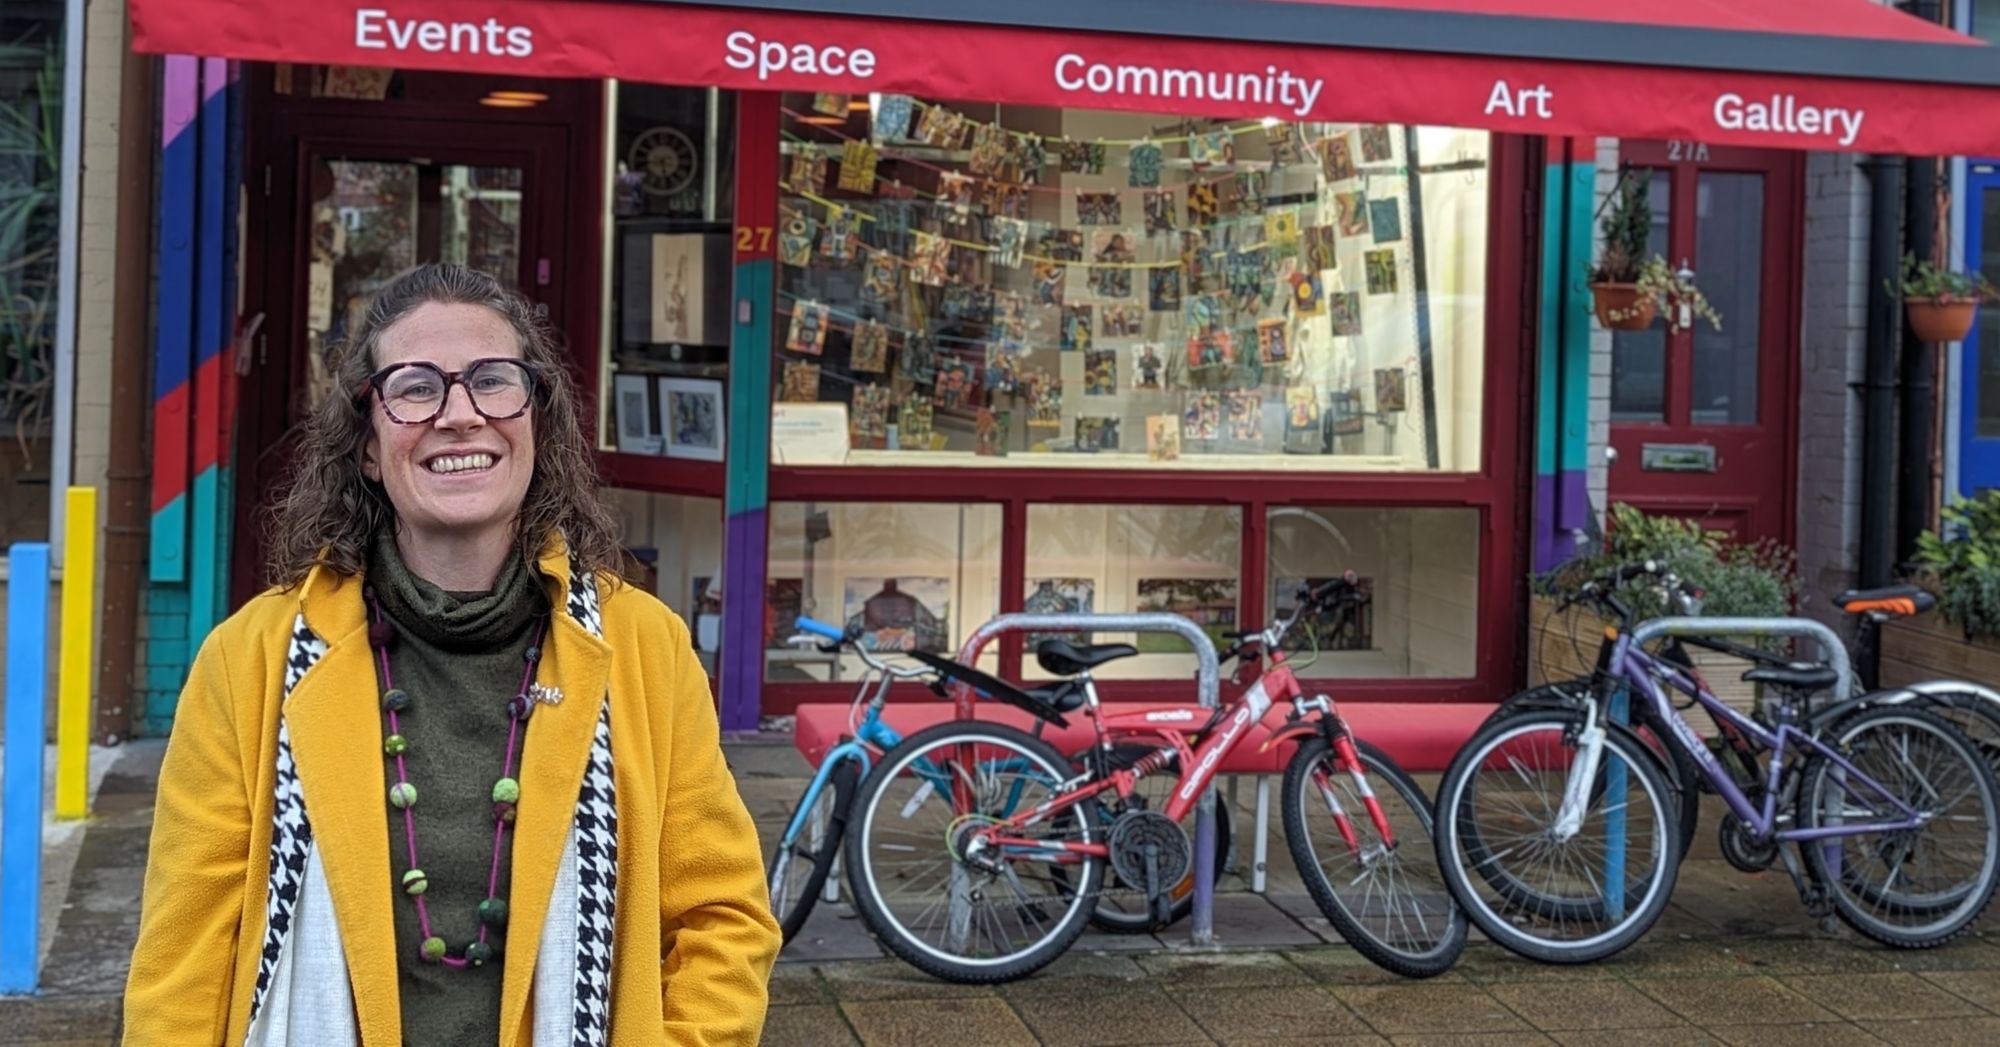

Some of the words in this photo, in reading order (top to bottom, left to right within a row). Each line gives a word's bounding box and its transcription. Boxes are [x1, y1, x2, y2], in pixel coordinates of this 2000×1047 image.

[356, 8, 533, 57] Events
[724, 30, 876, 81] Space
[1054, 53, 1324, 116] Community
[1484, 80, 1553, 118] Art
[1713, 93, 1865, 146] Gallery
[1667, 139, 1710, 162] 27A
[735, 226, 772, 252] 27
